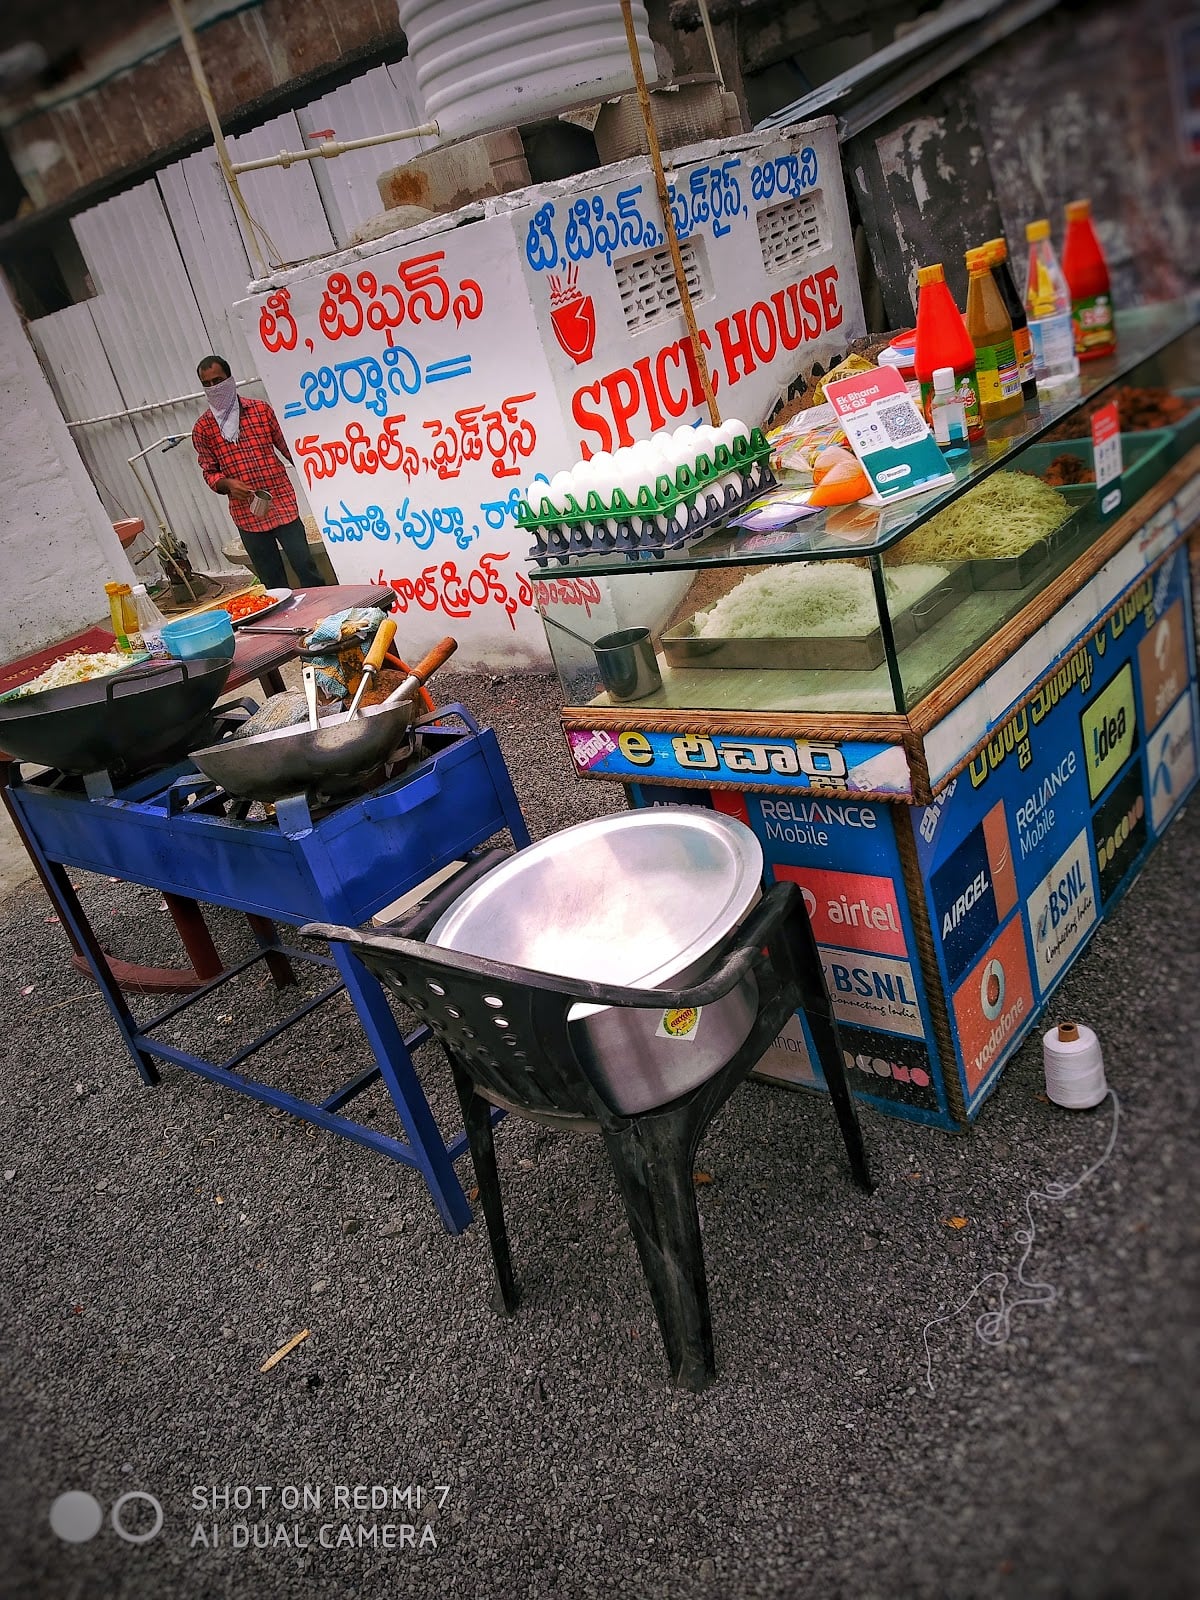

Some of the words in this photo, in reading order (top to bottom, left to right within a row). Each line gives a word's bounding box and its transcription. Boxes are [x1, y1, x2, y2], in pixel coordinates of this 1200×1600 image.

[571, 329, 719, 461] SPICE
[715, 265, 843, 385] HOUSE
[836, 395, 848, 405] Ek
[847, 385, 880, 401] Bharat
[852, 398, 867, 408] QR
[765, 822, 829, 847] Mobile
[1020, 809, 1055, 860] Mobile
[827, 895, 900, 933] airtel
[942, 870, 989, 941] AIRCEL
[1049, 860, 1086, 930] BSNL
[831, 964, 916, 1005] BSNL
[830, 992, 886, 1016] Connecting
[888, 1003, 918, 1019] India
[974, 996, 1025, 1071] vodafone
